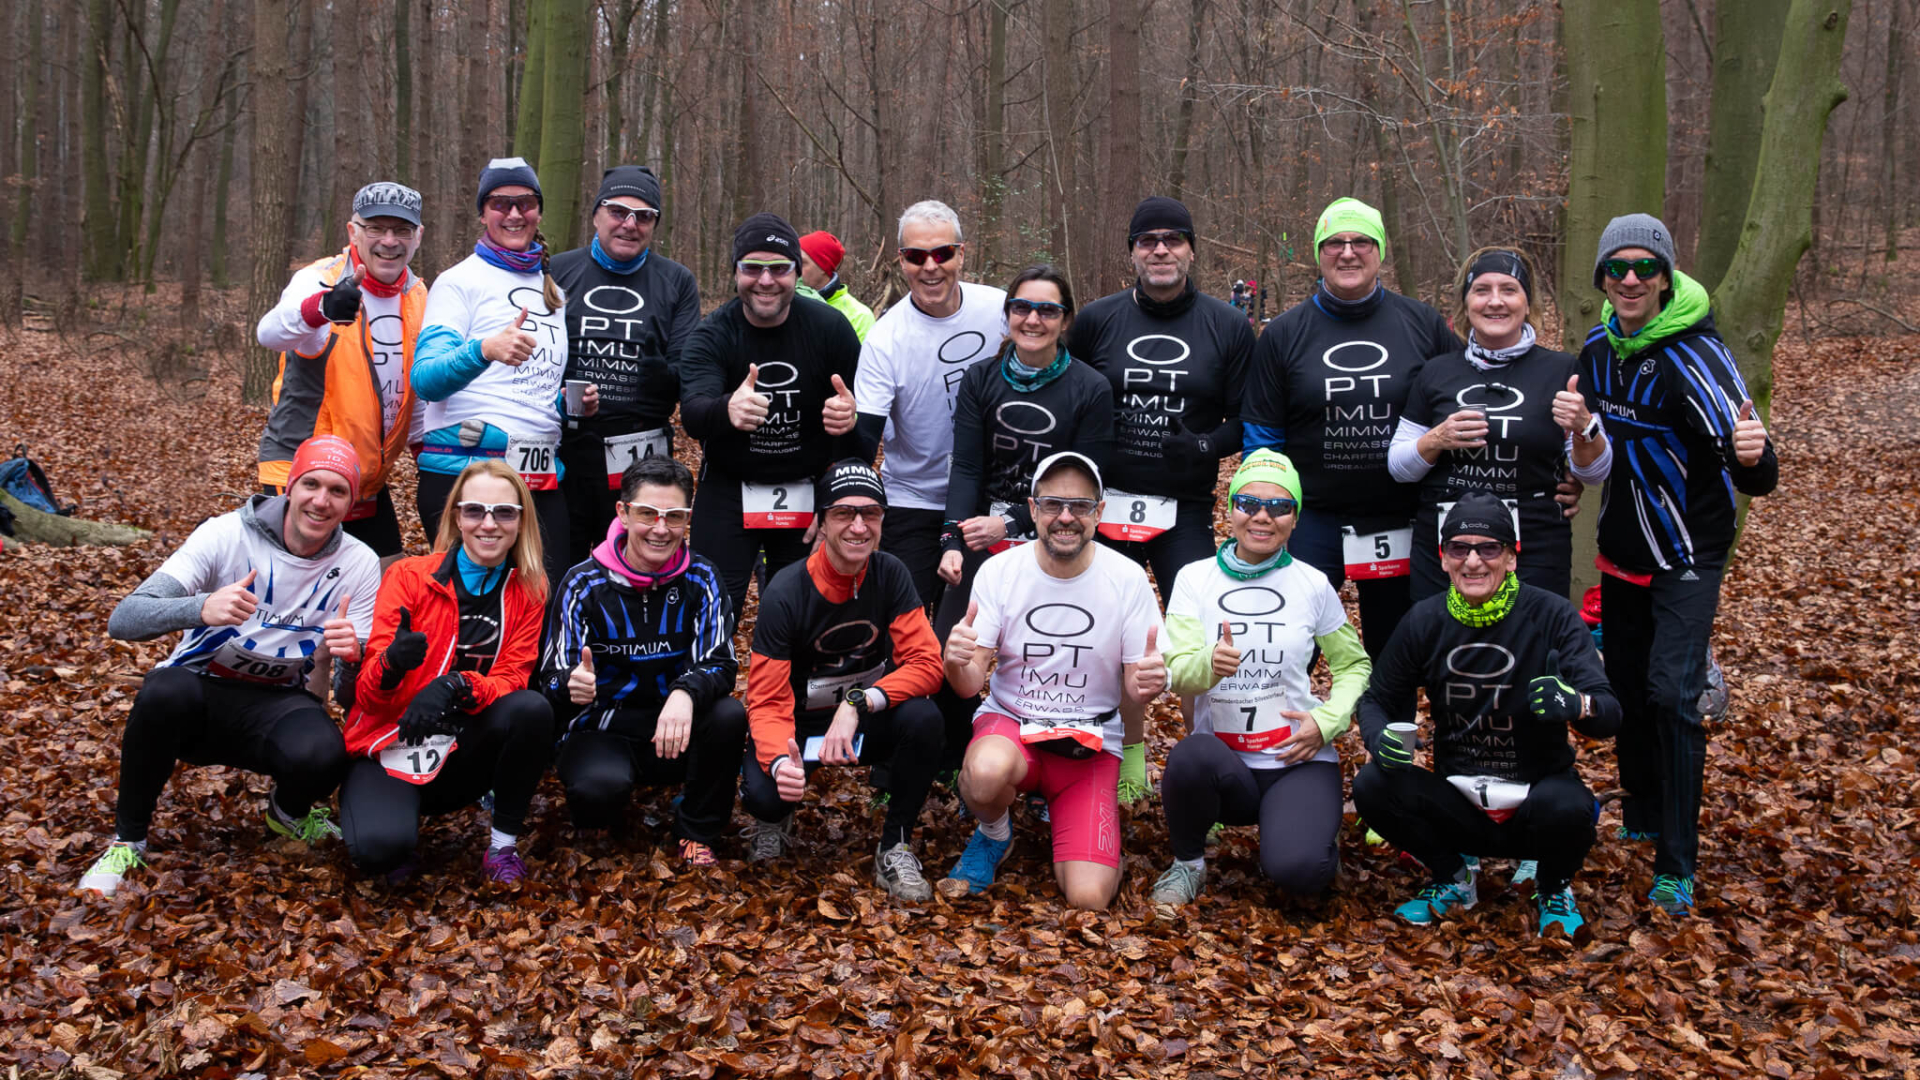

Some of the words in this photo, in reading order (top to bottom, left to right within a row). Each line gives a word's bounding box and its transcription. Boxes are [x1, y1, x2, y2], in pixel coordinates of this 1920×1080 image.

[583, 286, 644, 315] O
[580, 316, 643, 340] PT
[579, 340, 639, 359] IMU
[938, 331, 985, 364] O
[1126, 334, 1190, 365] O
[1322, 341, 1389, 372] O
[577, 357, 638, 373] MIMM
[756, 362, 798, 387] O
[944, 368, 966, 393] P
[1123, 368, 1189, 392] PT
[1325, 375, 1391, 401] PT
[1122, 394, 1185, 413] IMU
[1457, 383, 1524, 412] O
[765, 410, 800, 425] MU
[996, 401, 1056, 435] O
[1325, 403, 1391, 420] IMU
[1119, 427, 1171, 438] ERWAS
[1325, 424, 1391, 437] MIMM
[1488, 415, 1523, 439] T
[993, 433, 1052, 462] PT
[1323, 440, 1390, 450] ERWASS
[519, 447, 550, 472] 706
[1453, 464, 1518, 478] MIMM
[835, 466, 879, 481] MMM
[1447, 477, 1517, 492] ERWASS
[773, 487, 788, 510] 2
[1130, 500, 1147, 523] 8
[1375, 535, 1390, 559] 5
[1218, 586, 1286, 616] O
[1025, 603, 1095, 637] O
[814, 620, 879, 654] O
[1217, 622, 1286, 643] PT
[231, 655, 289, 678] 708
[1023, 642, 1093, 668] PT
[1447, 643, 1515, 678] O
[1021, 665, 1087, 688] IMU
[1019, 684, 1085, 703] MIMM
[1446, 682, 1513, 710] PT
[1240, 706, 1257, 732] 7
[407, 749, 441, 774] 12
[1475, 784, 1489, 808] 1
